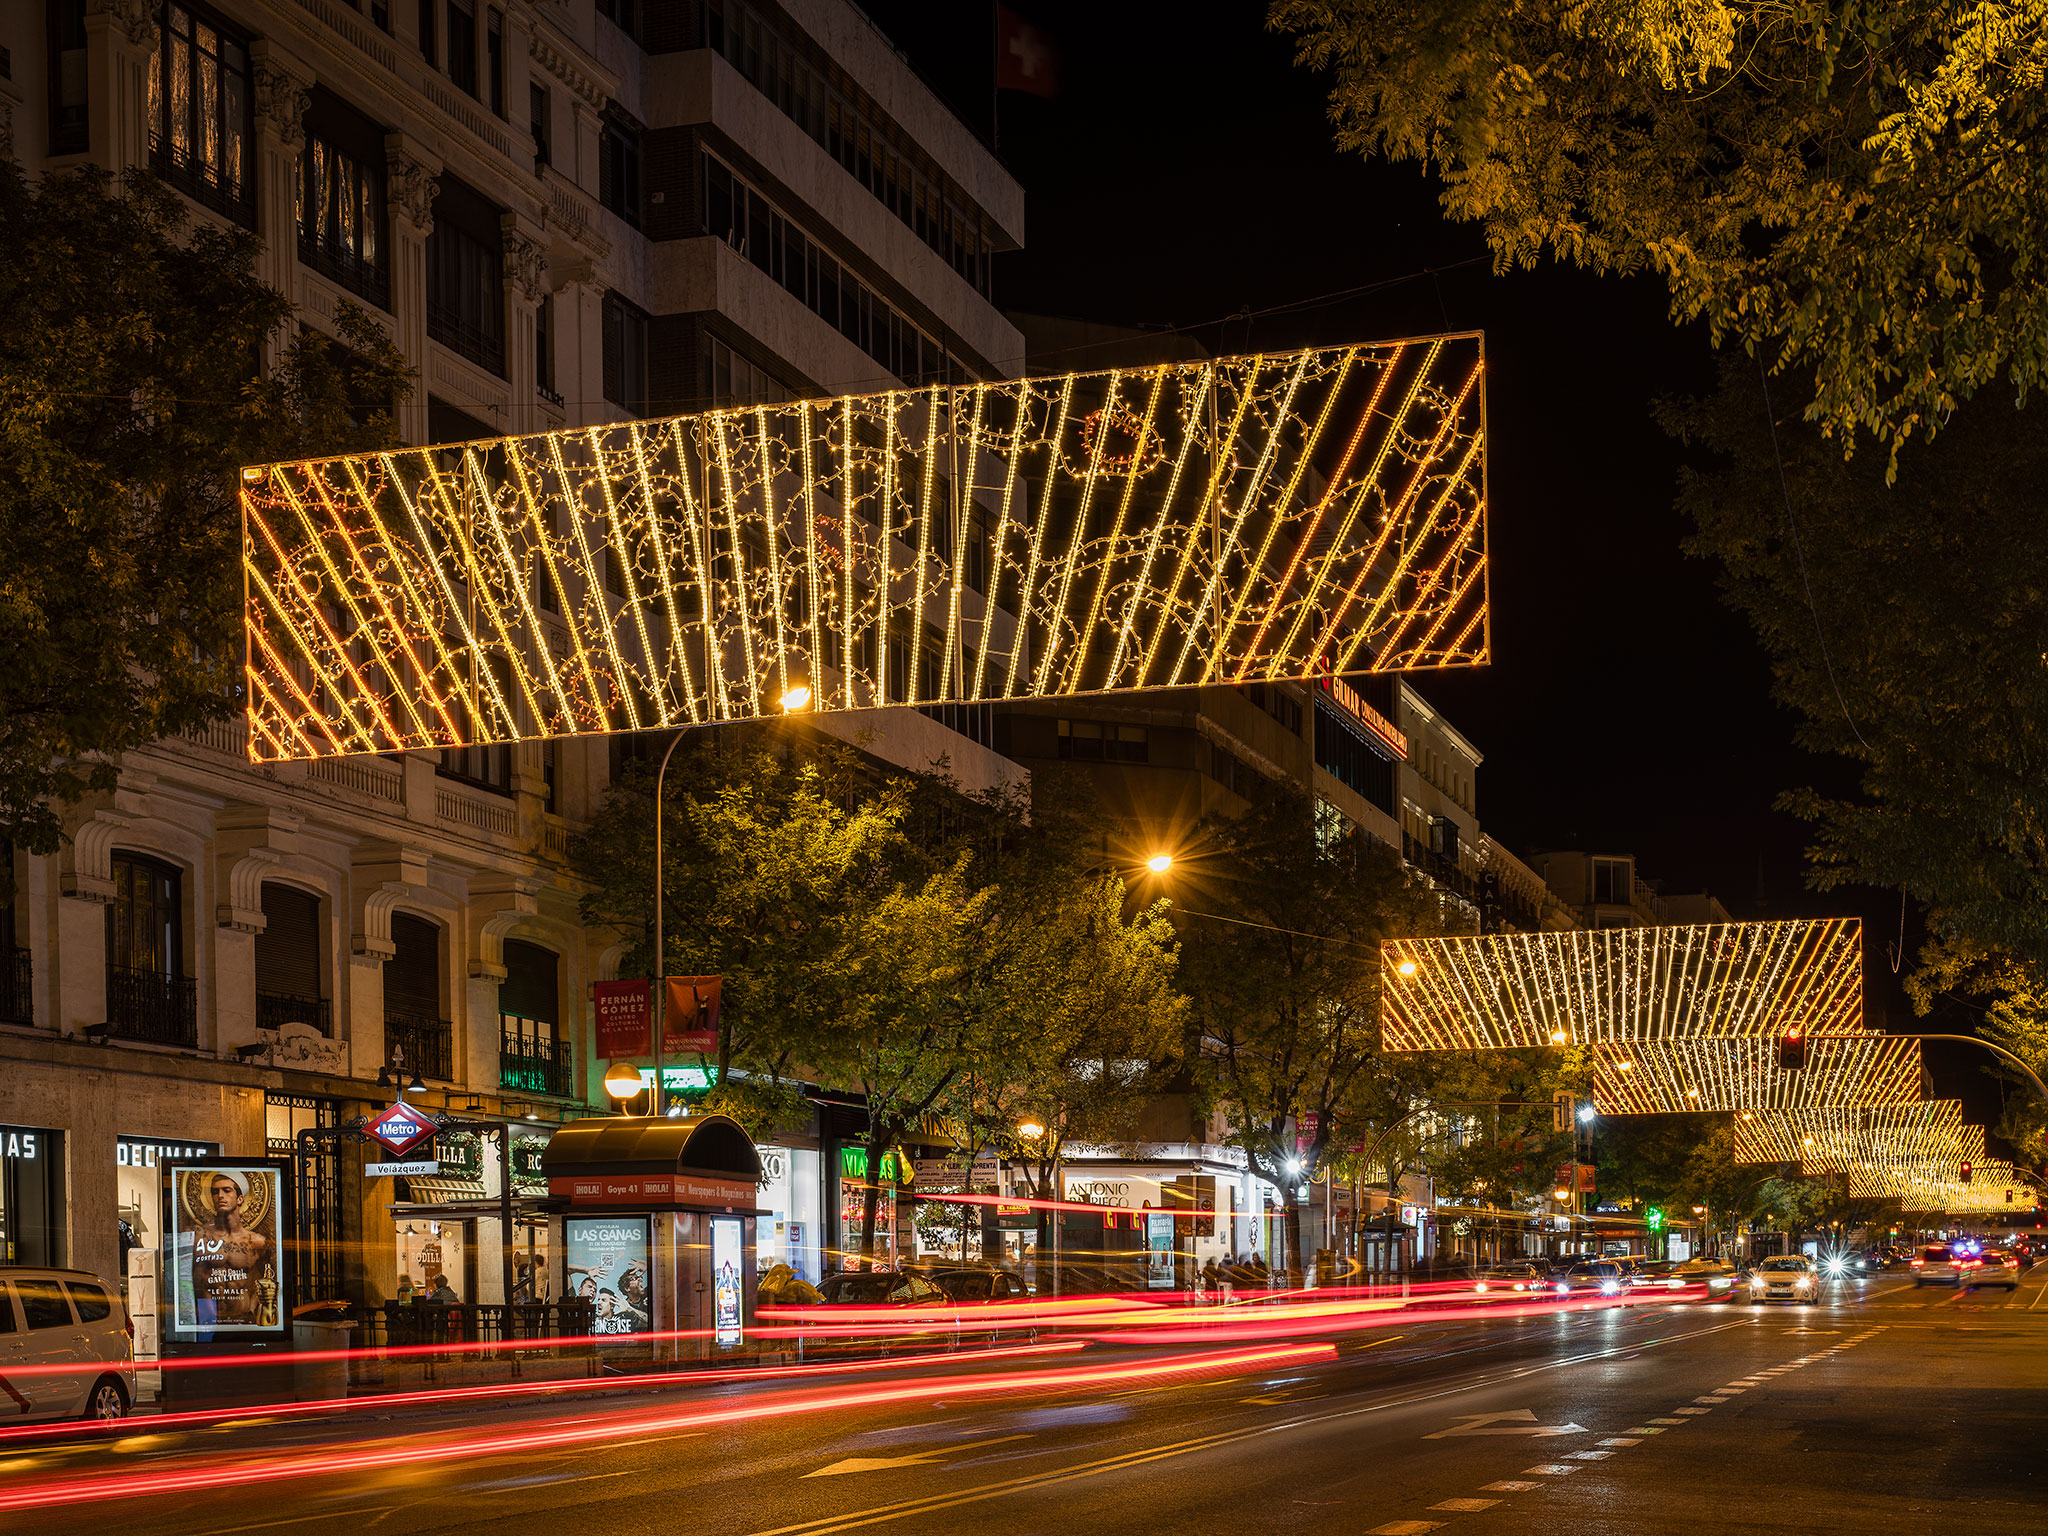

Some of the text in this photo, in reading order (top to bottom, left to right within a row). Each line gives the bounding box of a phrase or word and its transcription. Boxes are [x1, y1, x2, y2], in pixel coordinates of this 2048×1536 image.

[1333, 676, 1360, 718] GILMAR
[601, 993, 644, 1005] FERNÁN
[601, 1003, 644, 1015] GÓMEZ
[382, 1123, 415, 1135] Metro
[0, 1132, 36, 1159] AS
[436, 1145, 466, 1164] ILLA
[377, 1164, 426, 1174] Velázquez
[844, 1154, 893, 1180] VIAAS
[607, 1185, 626, 1195] Goya
[628, 1184, 638, 1193] 41
[688, 1183, 716, 1199] Newspapers
[720, 1186, 744, 1201] Magazines
[1069, 1182, 1129, 1195] ANTONIO
[574, 1228, 641, 1241] LAS GANAS
[207, 1272, 248, 1284] GAULTIER
[211, 1268, 244, 1276] Jean Paul
